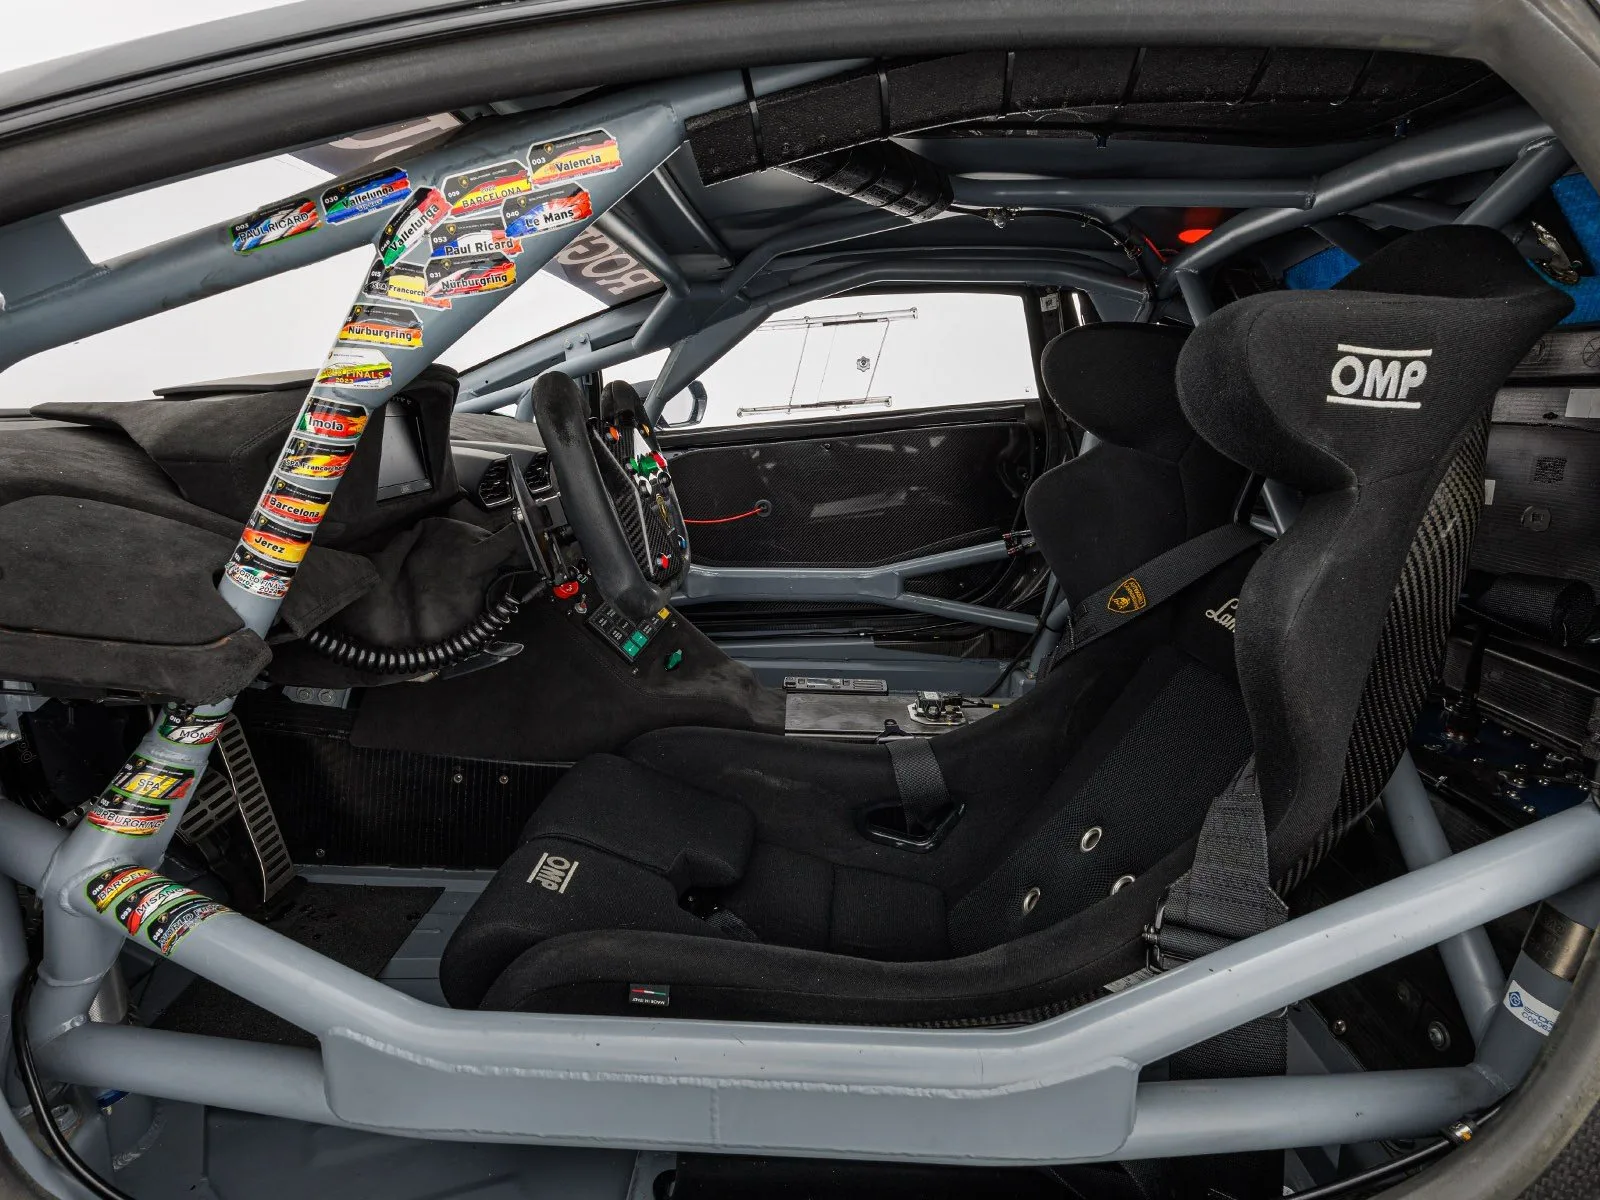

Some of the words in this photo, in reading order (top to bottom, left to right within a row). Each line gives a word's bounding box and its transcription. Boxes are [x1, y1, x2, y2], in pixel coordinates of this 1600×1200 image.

[555, 154, 602, 171] Valencia
[341, 185, 395, 208] Vallelunga
[462, 187, 521, 208] BARCELONA
[268, 213, 309, 233] RICARD
[389, 204, 439, 251] Vallelunga
[525, 217, 540, 228] Le
[543, 209, 574, 223] Mans
[445, 244, 471, 256] Paul
[475, 238, 514, 253] Ricard
[441, 274, 508, 291] Nürburgring
[348, 326, 412, 342] Nürburgring
[1330, 354, 1429, 400] OMP
[308, 416, 344, 431] Imola
[270, 496, 320, 518] Barcelona
[255, 536, 286, 554] Jerez
[137, 778, 161, 790] SPA
[535, 856, 571, 891] OMP
